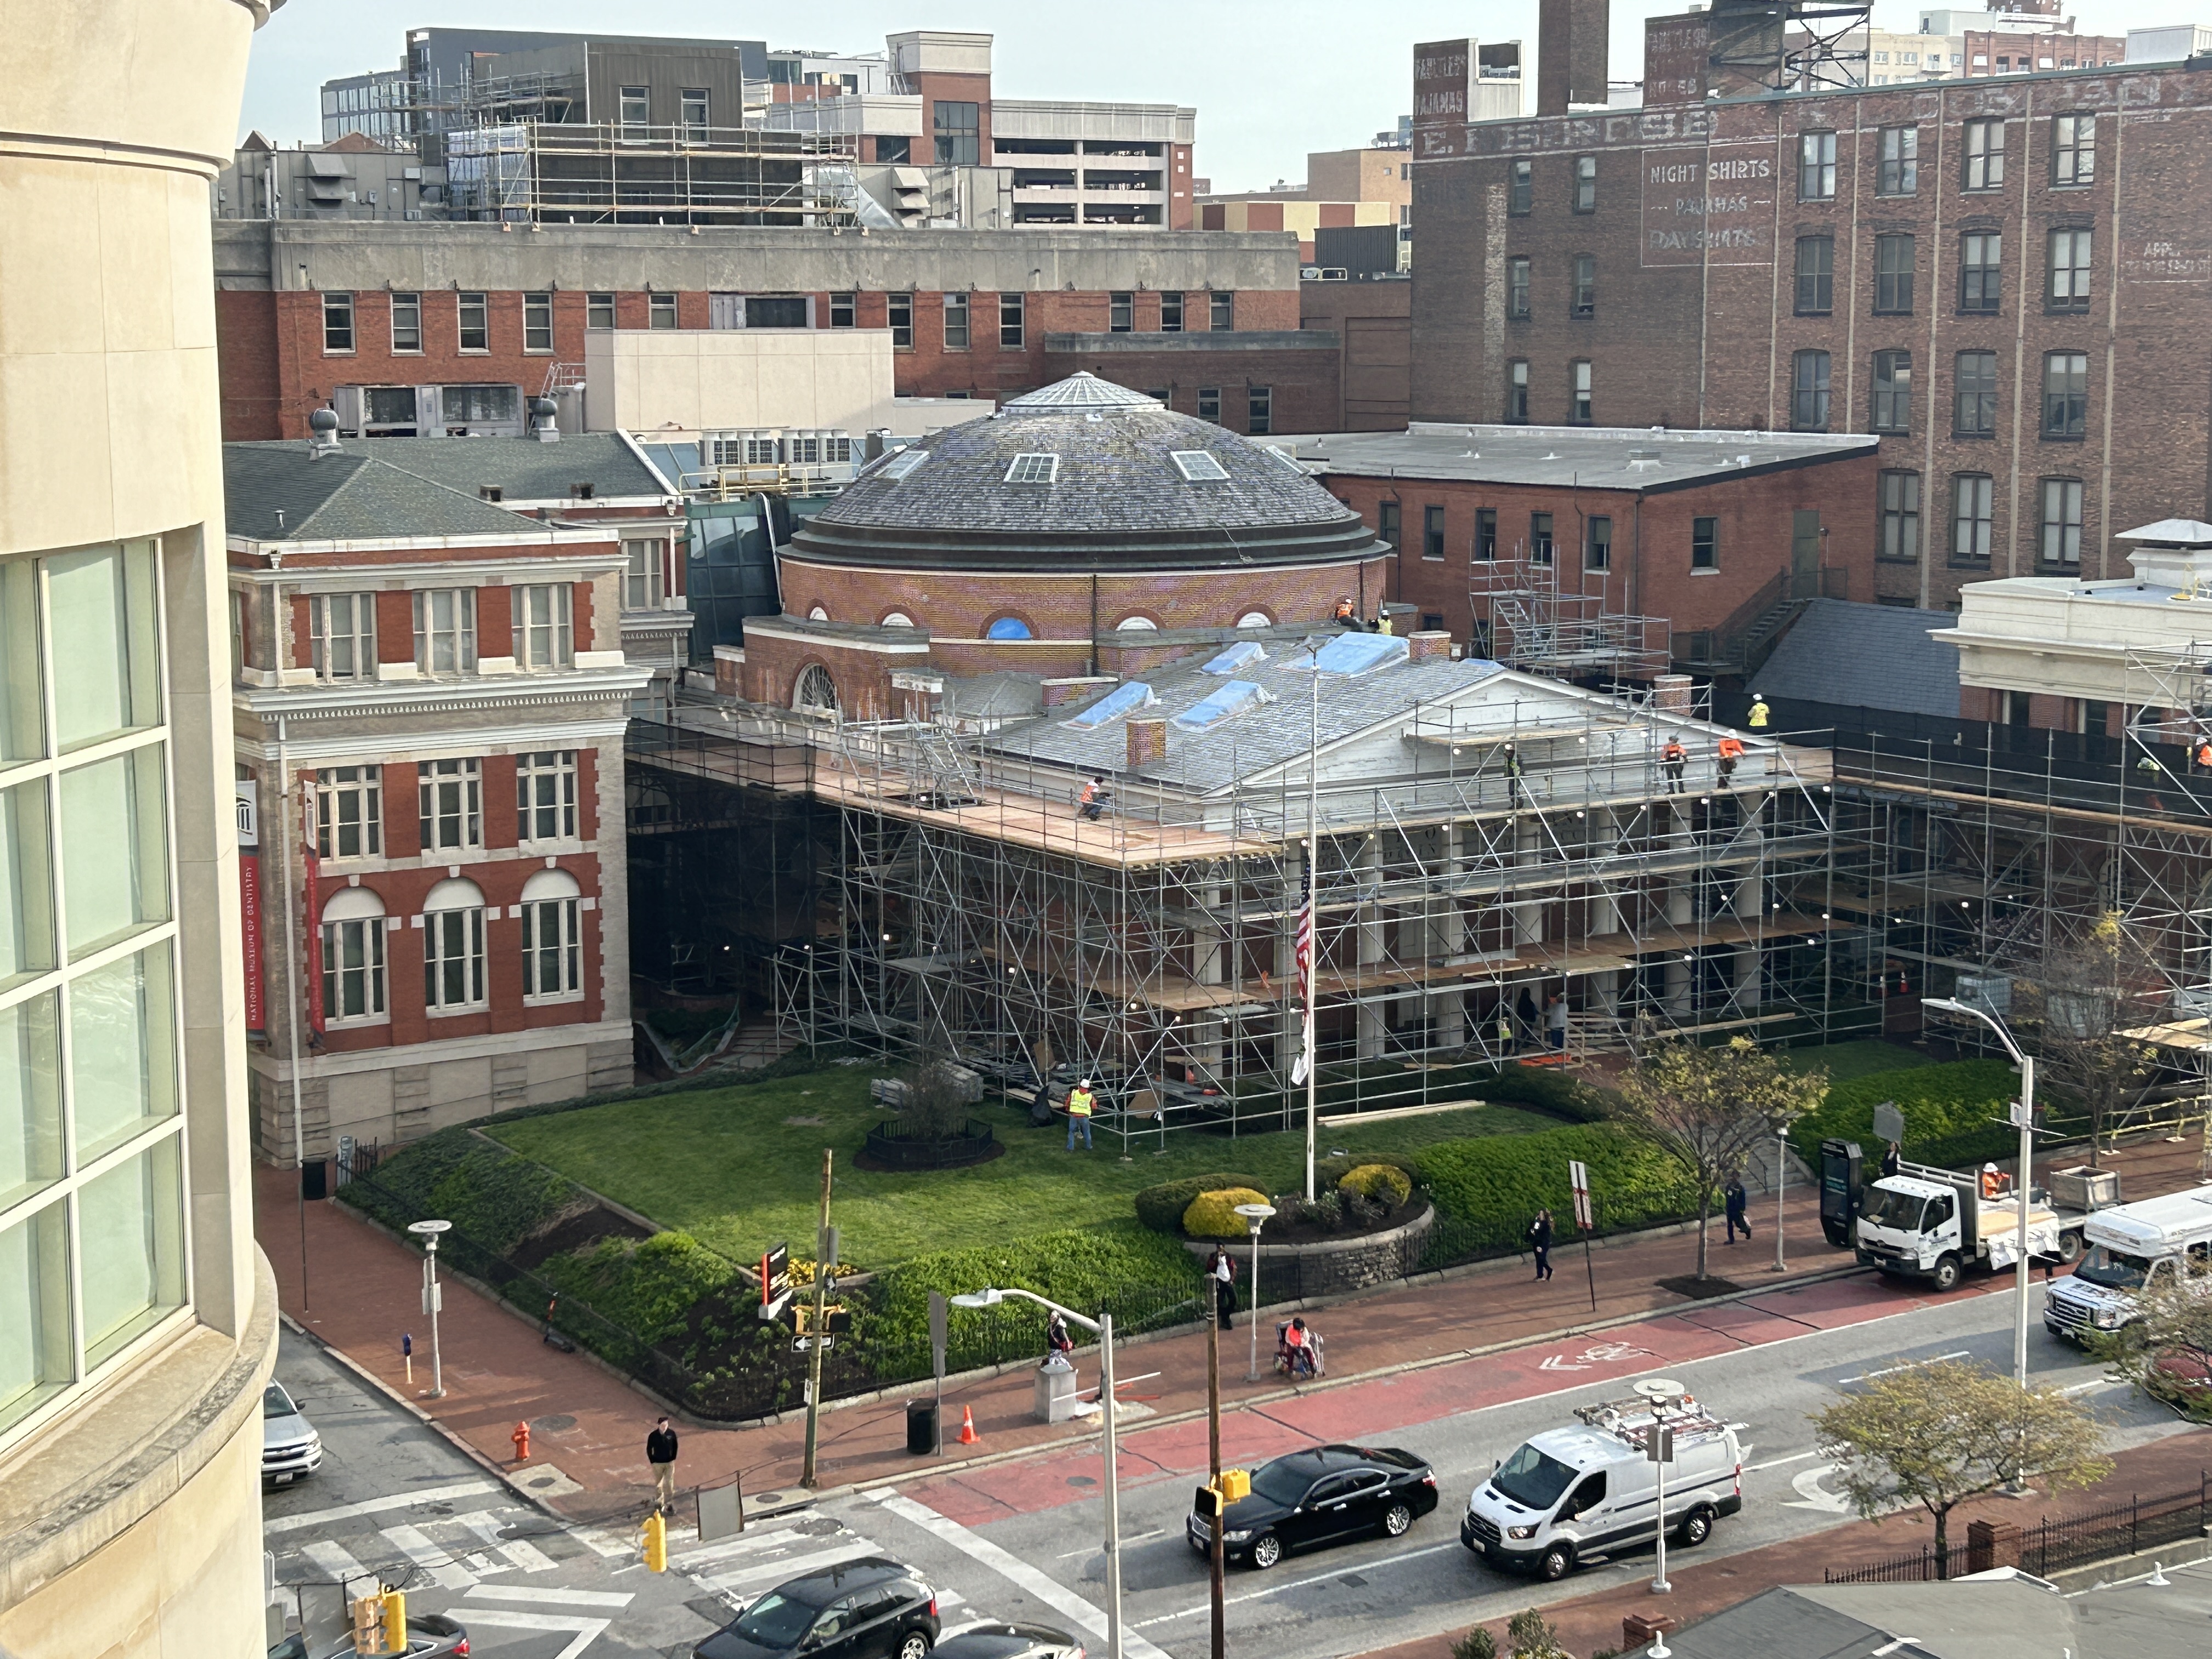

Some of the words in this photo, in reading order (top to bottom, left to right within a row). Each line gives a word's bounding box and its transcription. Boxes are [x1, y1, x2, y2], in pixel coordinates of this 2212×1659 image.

[1650, 165, 1699, 184] NIGHT
[1708, 159, 1770, 180] SHIRTS
[245, 866, 254, 916] DENTISTRY
[247, 919, 255, 932] OF
[248, 975, 257, 1021] NATIONAL
